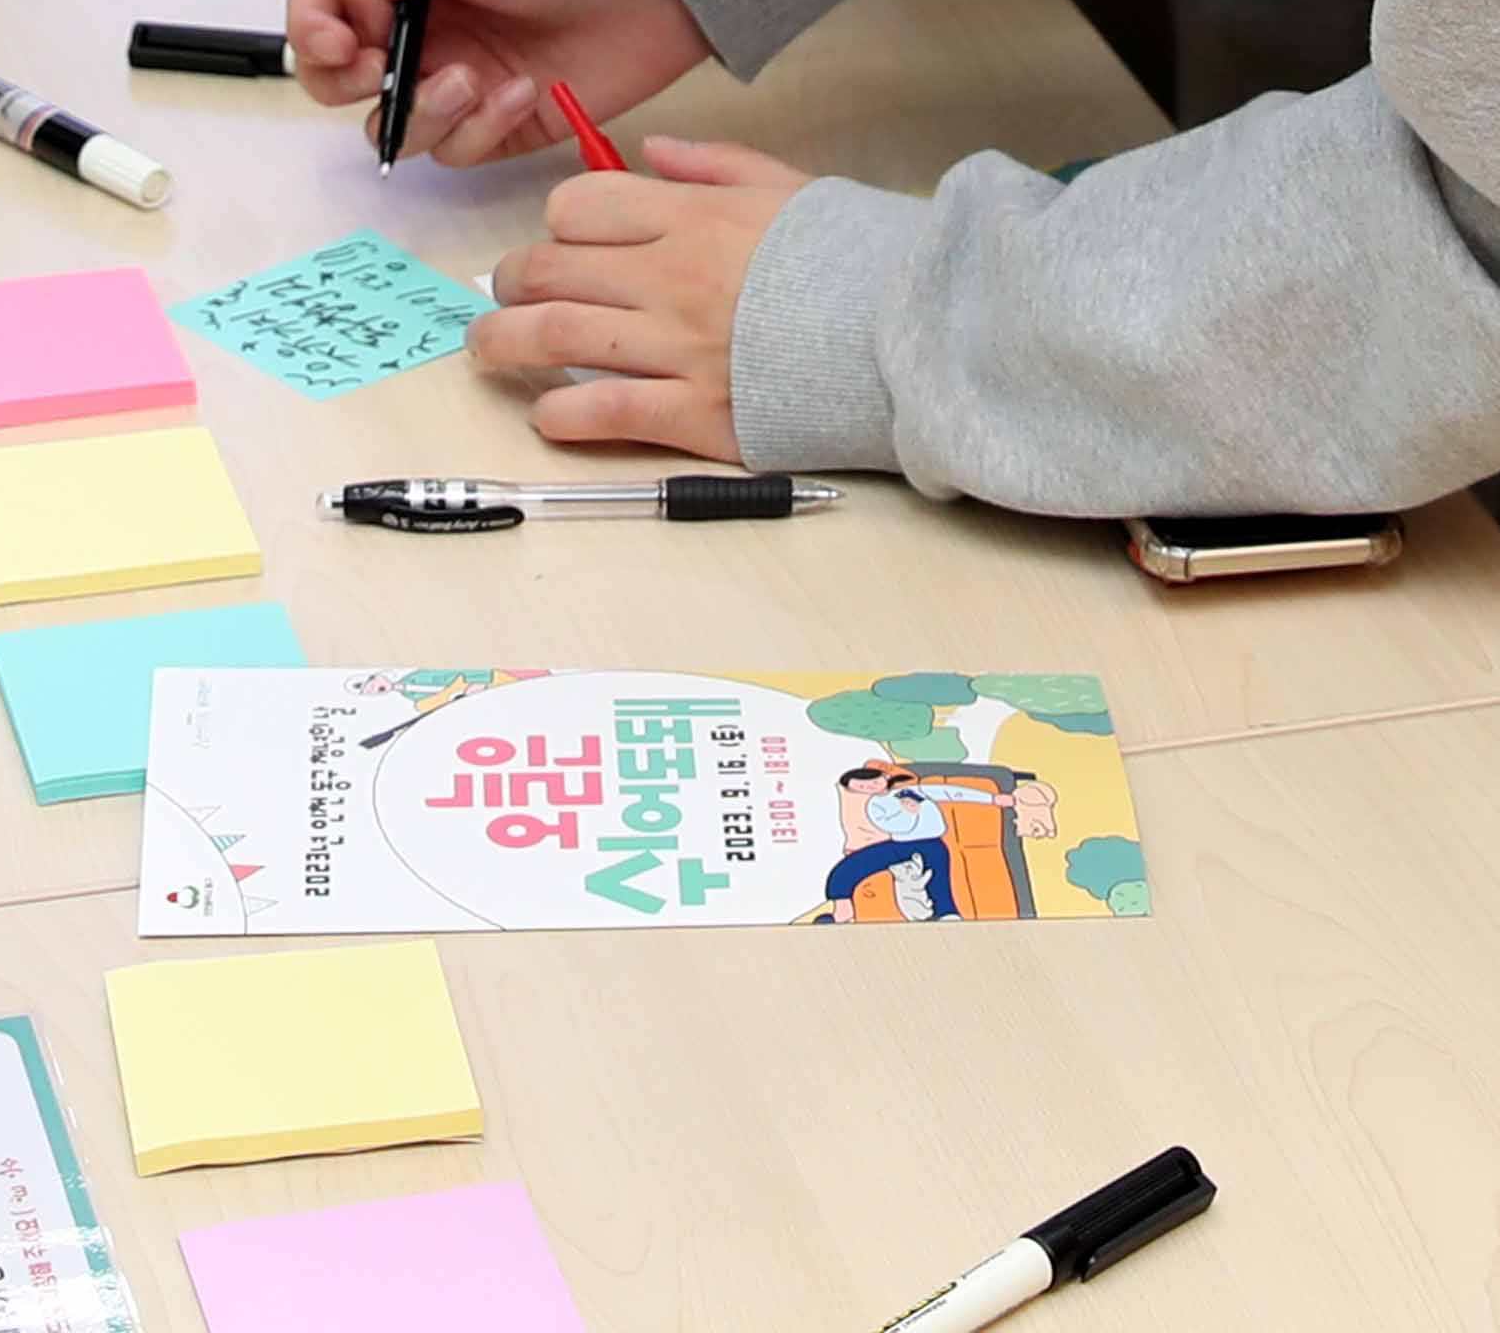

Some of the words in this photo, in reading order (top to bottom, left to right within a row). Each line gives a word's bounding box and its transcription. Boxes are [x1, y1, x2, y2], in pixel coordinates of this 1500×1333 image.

[760, 736, 790, 774] 18:00
[425, 735, 603, 849] 오늘은
[585, 698, 741, 914] 쉬어도돼
[767, 800, 799, 843] 13:00
[723, 804, 756, 861] 2023.
[305, 835, 345, 897] 2023년
